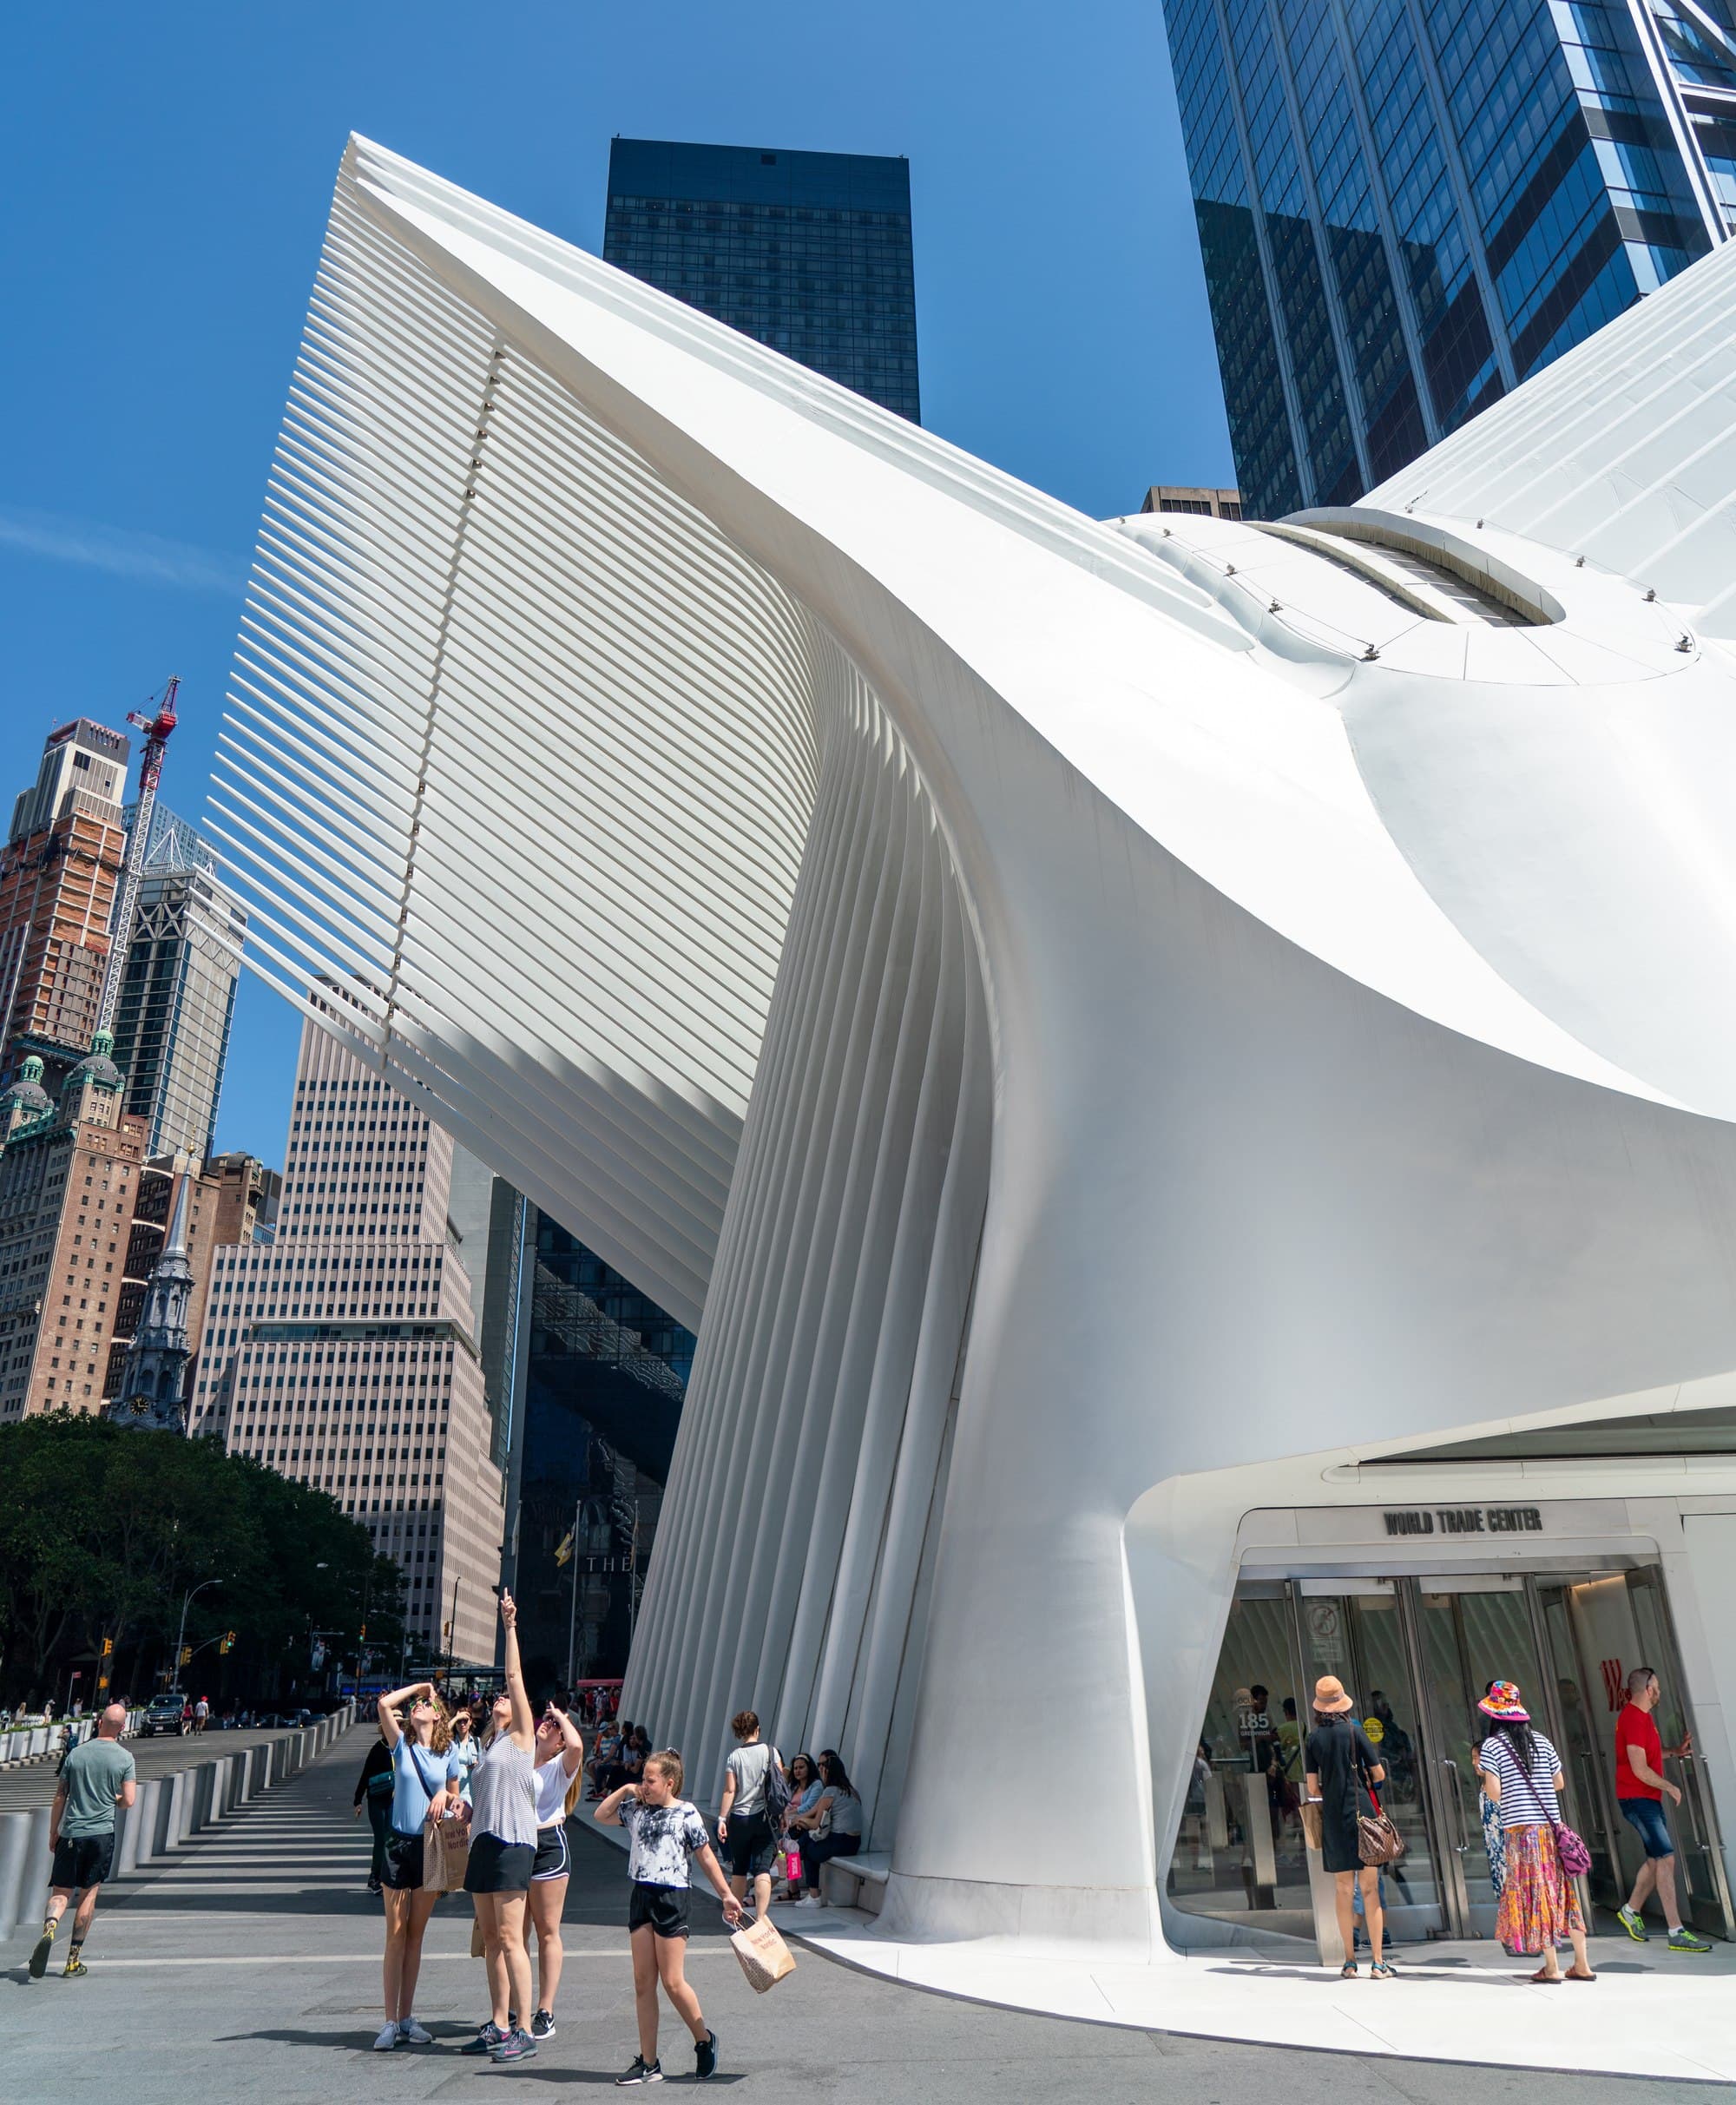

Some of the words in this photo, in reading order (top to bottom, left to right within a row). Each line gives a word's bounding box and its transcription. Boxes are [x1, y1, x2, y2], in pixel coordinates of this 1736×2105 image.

[1384, 1511, 1434, 1535] WORLD
[1437, 1510, 1485, 1533] TRADE
[1486, 1508, 1542, 1532] CENTER
[586, 1556, 630, 1572] THE
[1239, 1714, 1269, 1729] 185
